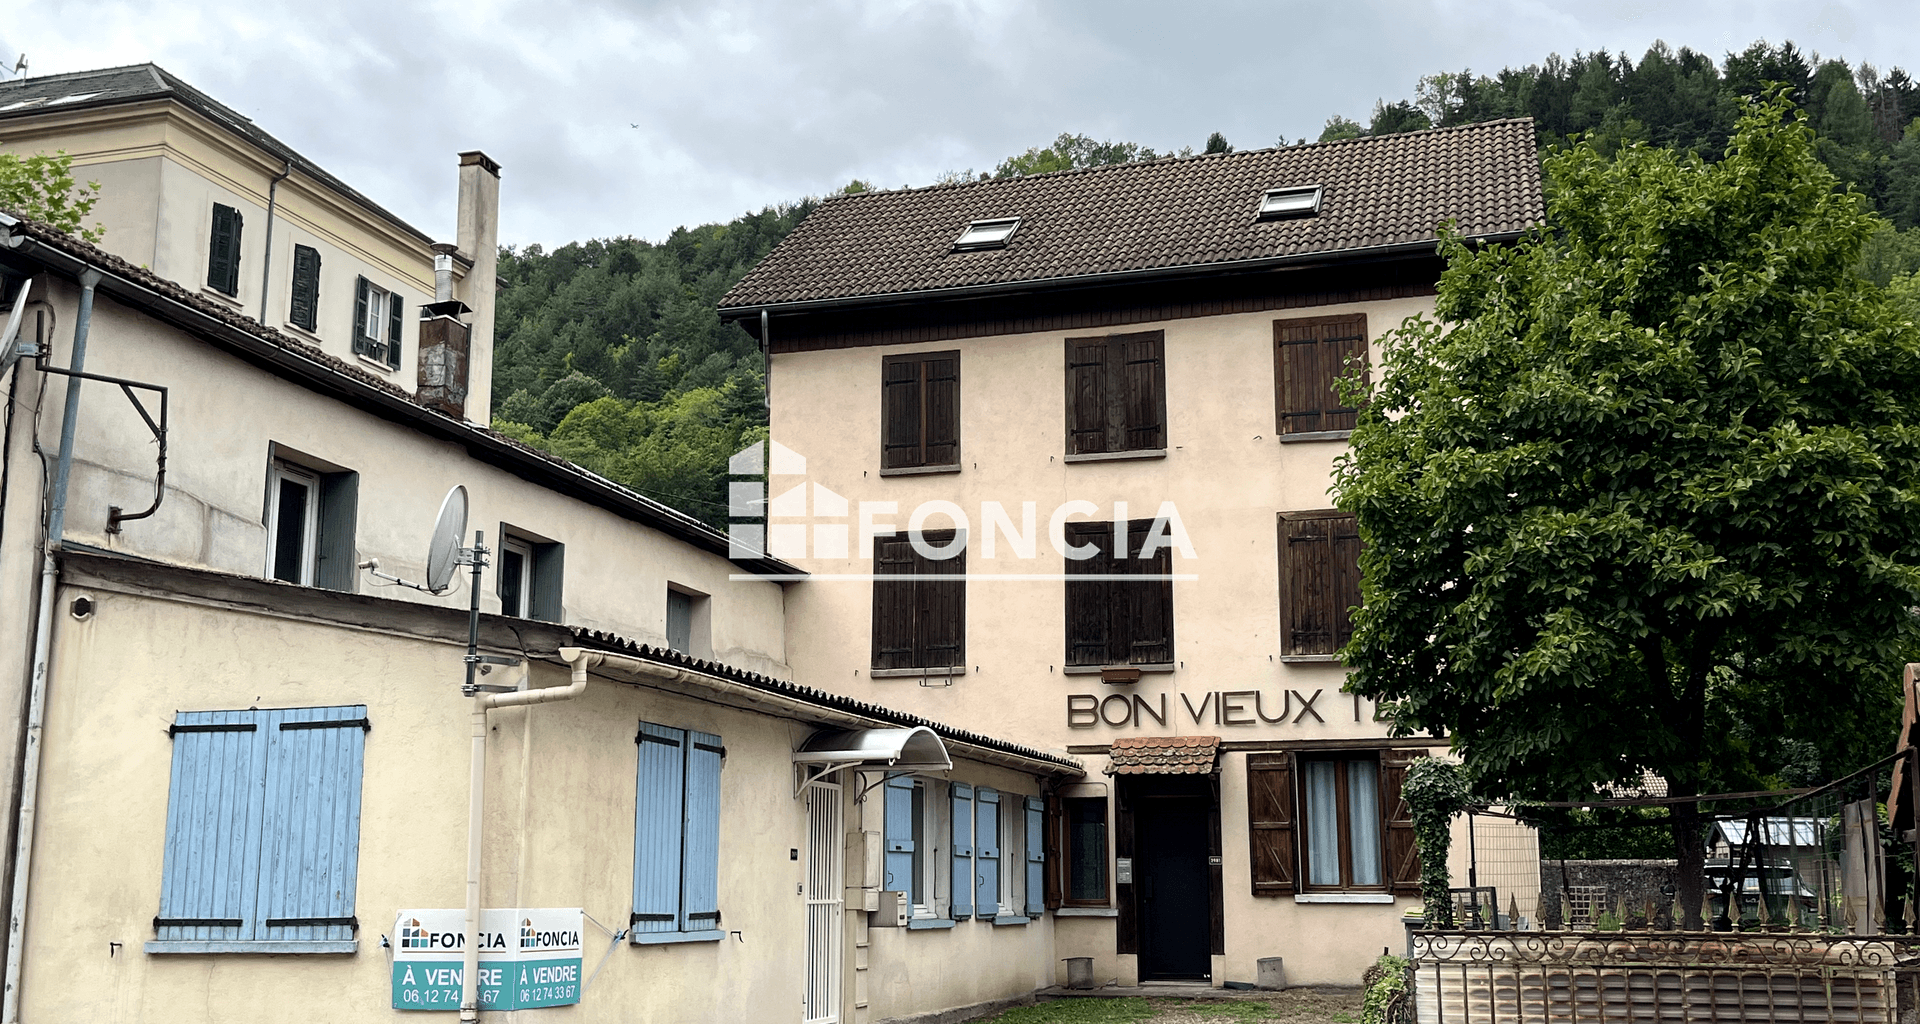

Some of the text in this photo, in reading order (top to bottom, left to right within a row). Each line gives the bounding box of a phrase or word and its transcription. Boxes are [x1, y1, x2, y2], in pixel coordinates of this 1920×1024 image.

[1067, 692, 1167, 728] BON
[1180, 688, 1325, 725] VIEUX
[536, 931, 579, 947] FONCIA
[402, 965, 503, 986] À VENRE
[519, 964, 577, 986] À VENDRE
[403, 989, 419, 1003] 06
[424, 989, 439, 1003] 12
[443, 989, 459, 1003] 74
[483, 990, 500, 1004] 67
[520, 985, 576, 1002] 06 12 74 33 67
